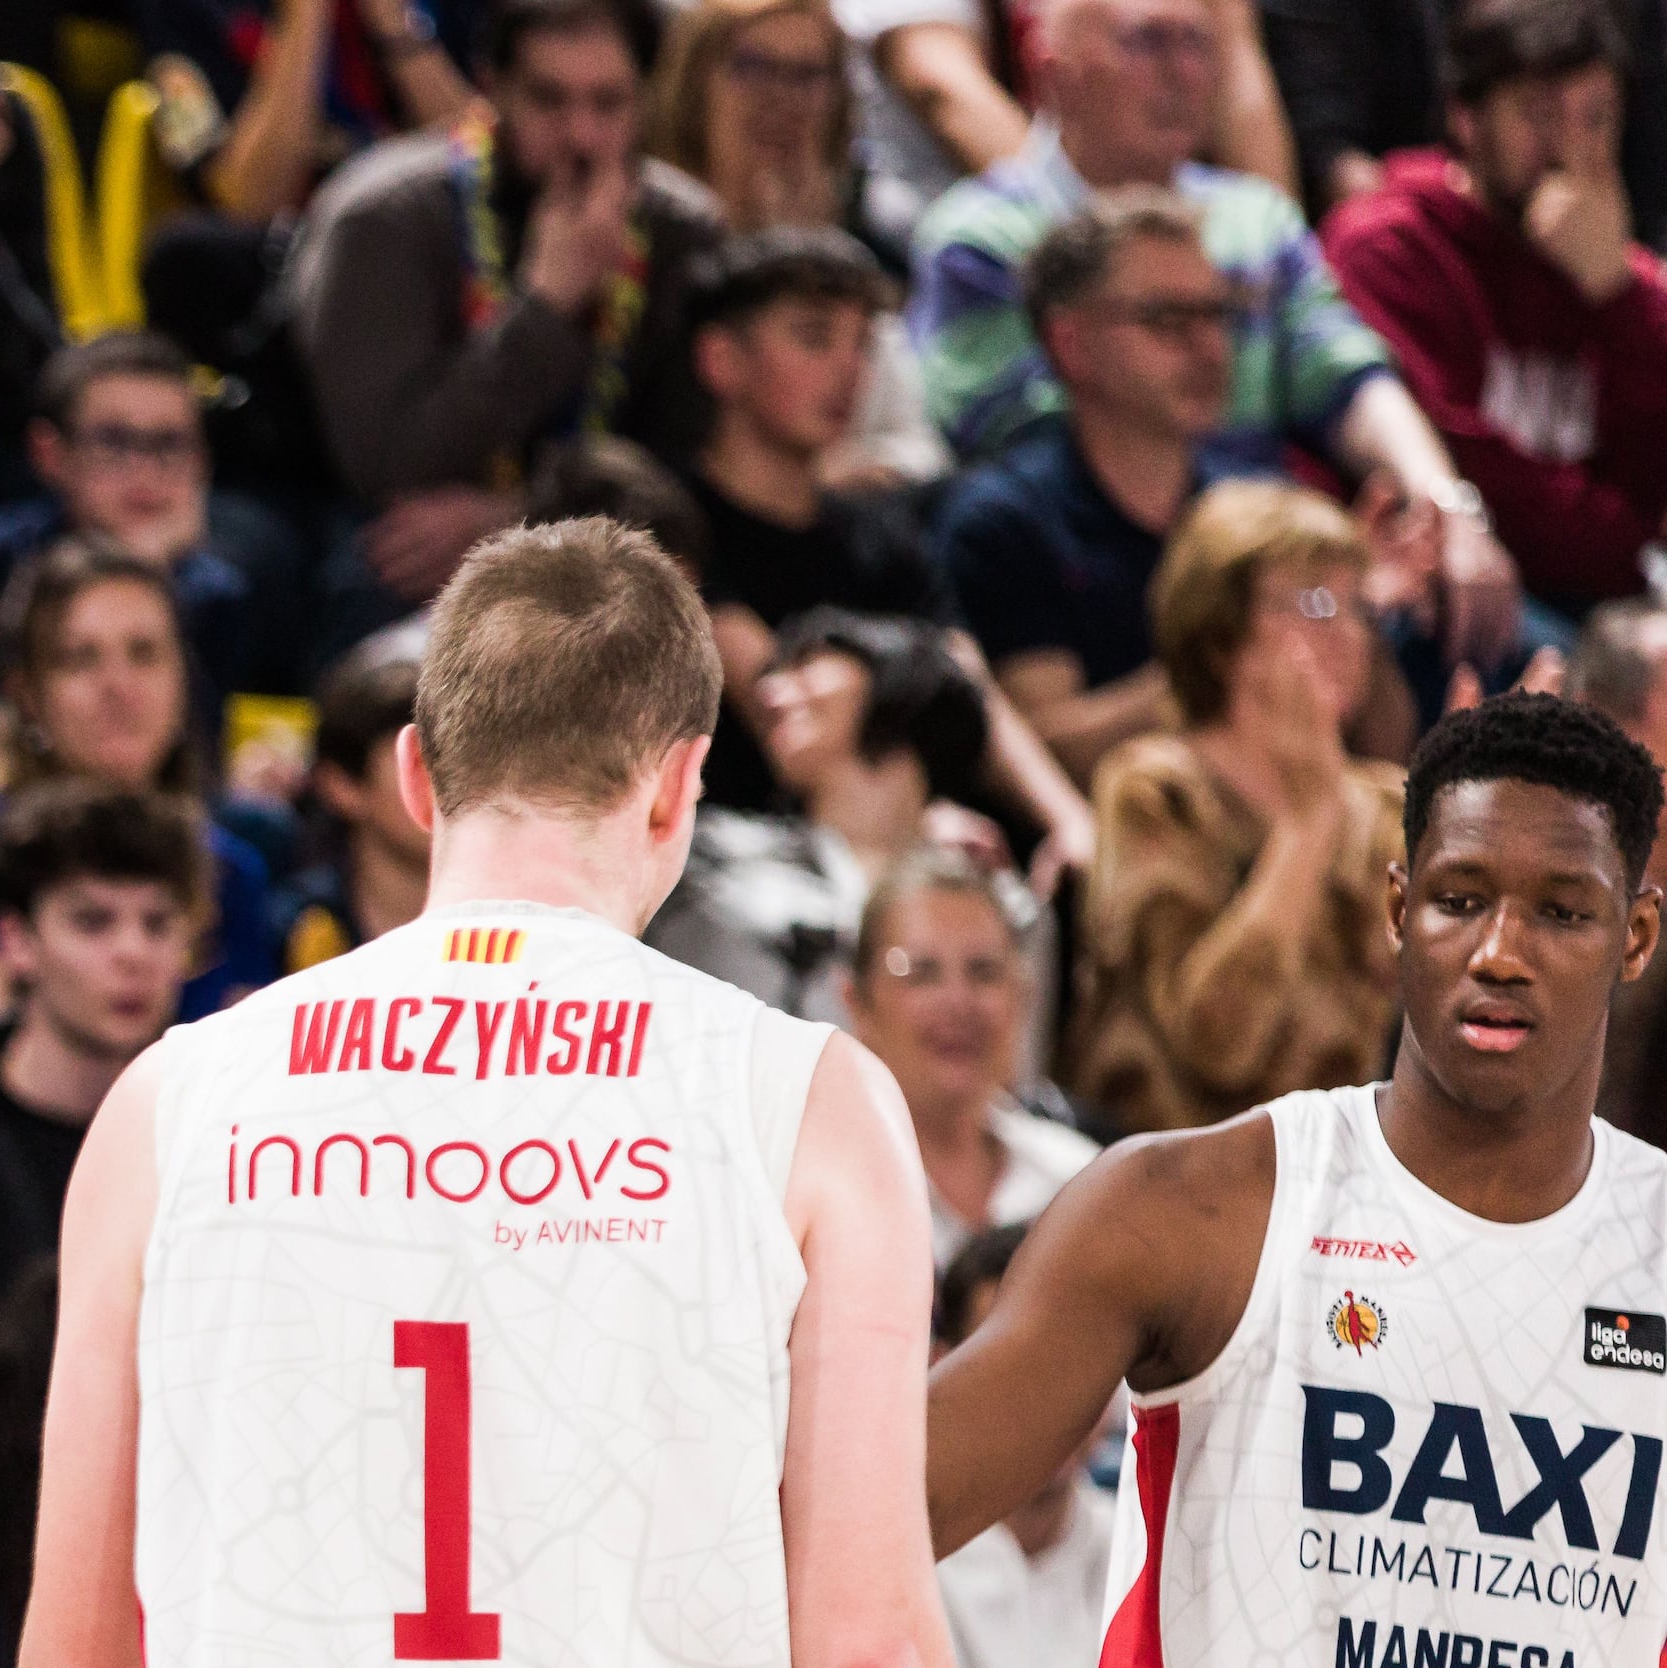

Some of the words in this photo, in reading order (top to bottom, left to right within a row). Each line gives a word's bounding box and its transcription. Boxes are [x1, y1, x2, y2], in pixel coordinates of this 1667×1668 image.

[288, 982, 652, 1080] WACZYŃSKI
[228, 1124, 672, 1205] inmoovs
[494, 1220, 527, 1251] by
[537, 1217, 667, 1246] AVINENT
[1590, 1343, 1665, 1370] endesa
[1591, 1321, 1627, 1346] liga
[393, 1320, 501, 1660] 1
[1300, 1384, 1664, 1561] BAXI
[1298, 1527, 1638, 1619] CLIMATIZACIÓN
